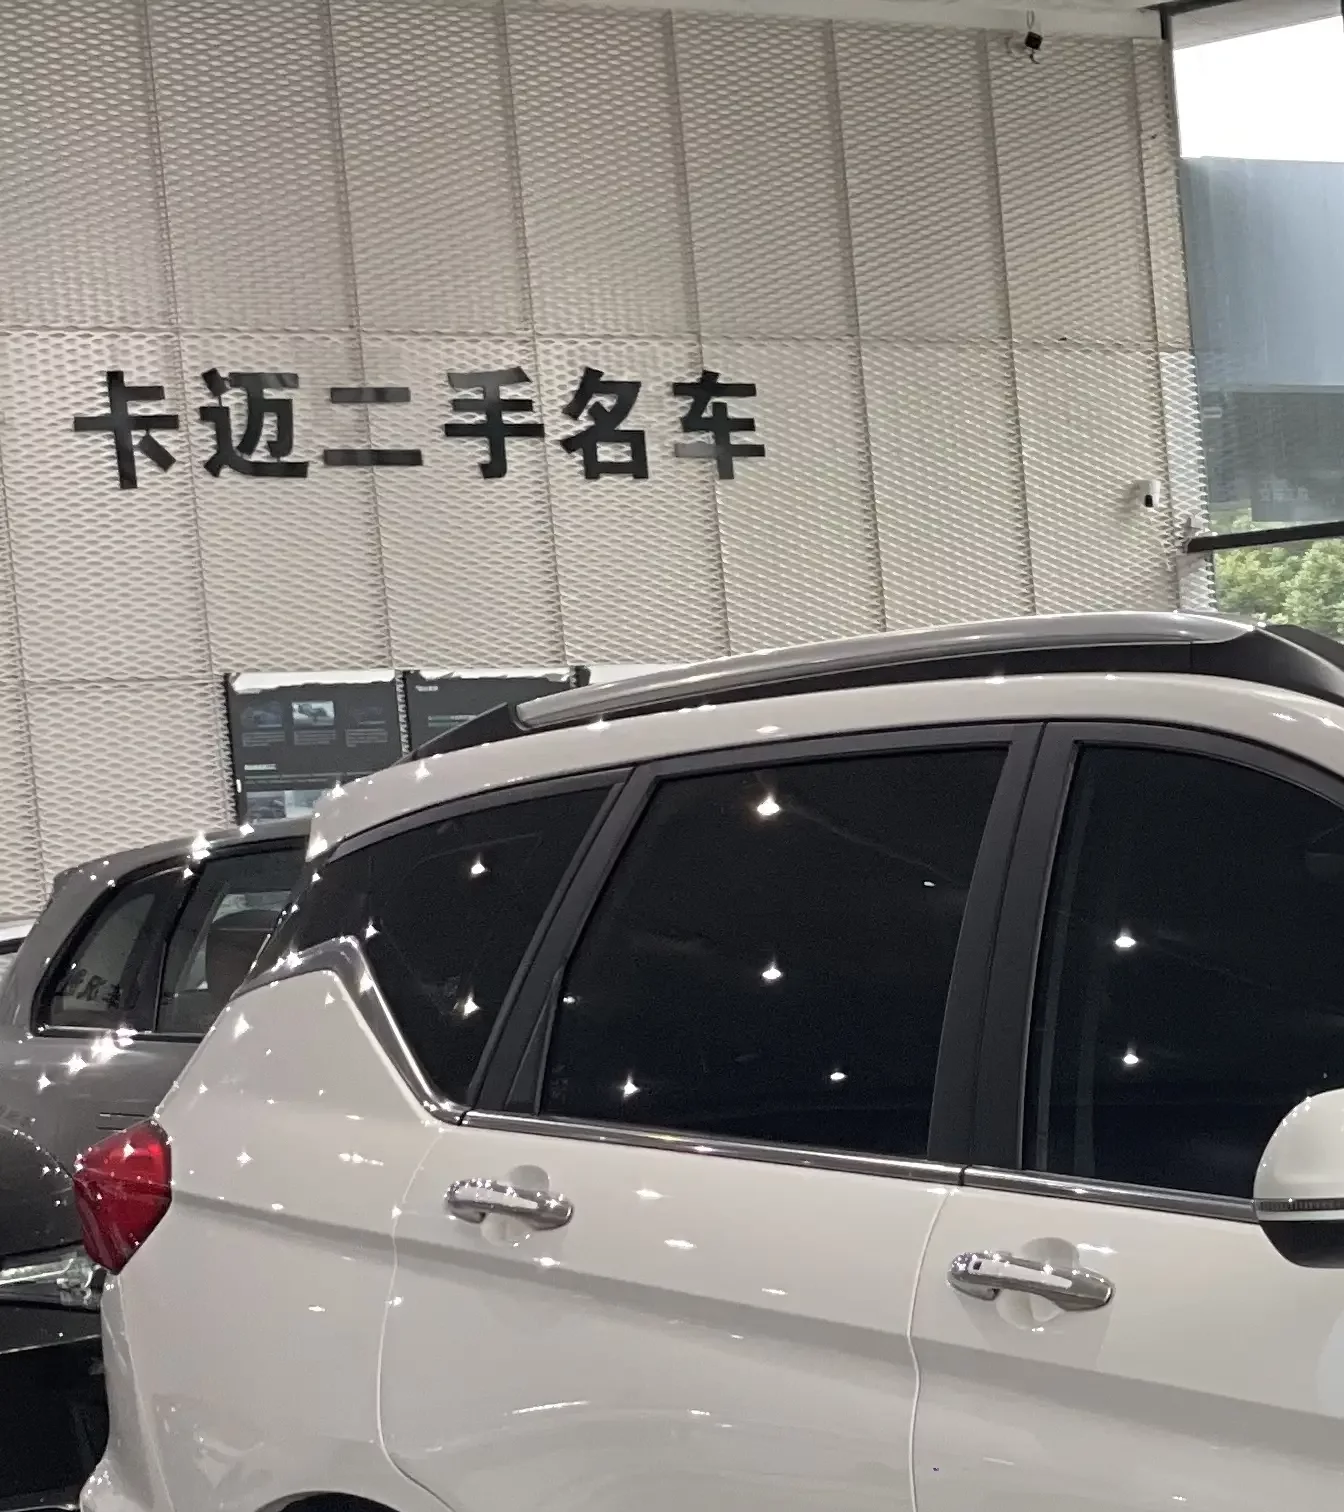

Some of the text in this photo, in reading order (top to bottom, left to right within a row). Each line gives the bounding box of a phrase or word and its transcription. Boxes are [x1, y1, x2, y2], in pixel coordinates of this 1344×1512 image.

[74, 367, 766, 489] 卡迈二手名车
